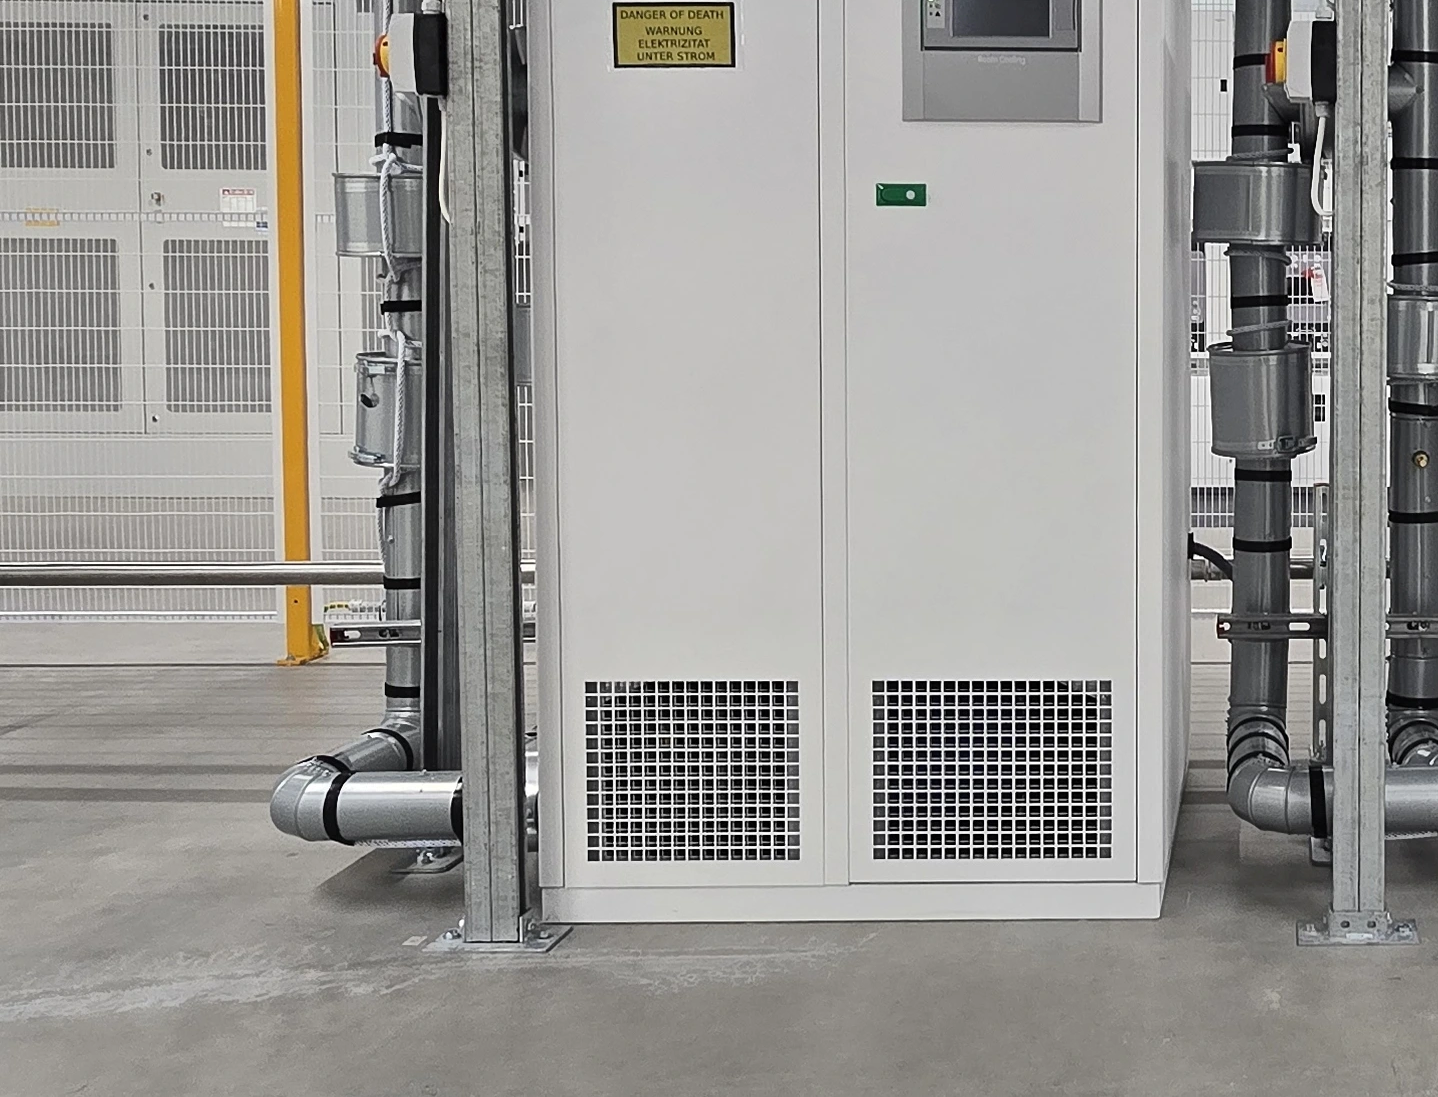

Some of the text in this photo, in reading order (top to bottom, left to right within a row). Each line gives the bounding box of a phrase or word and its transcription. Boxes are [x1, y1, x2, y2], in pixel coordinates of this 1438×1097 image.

[620, 10, 724, 20] DANGER OF DEATH
[645, 26, 703, 36] WARNUNG
[638, 39, 711, 49] ELEKTRIZITAT
[637, 52, 716, 61] UNTER STROM
